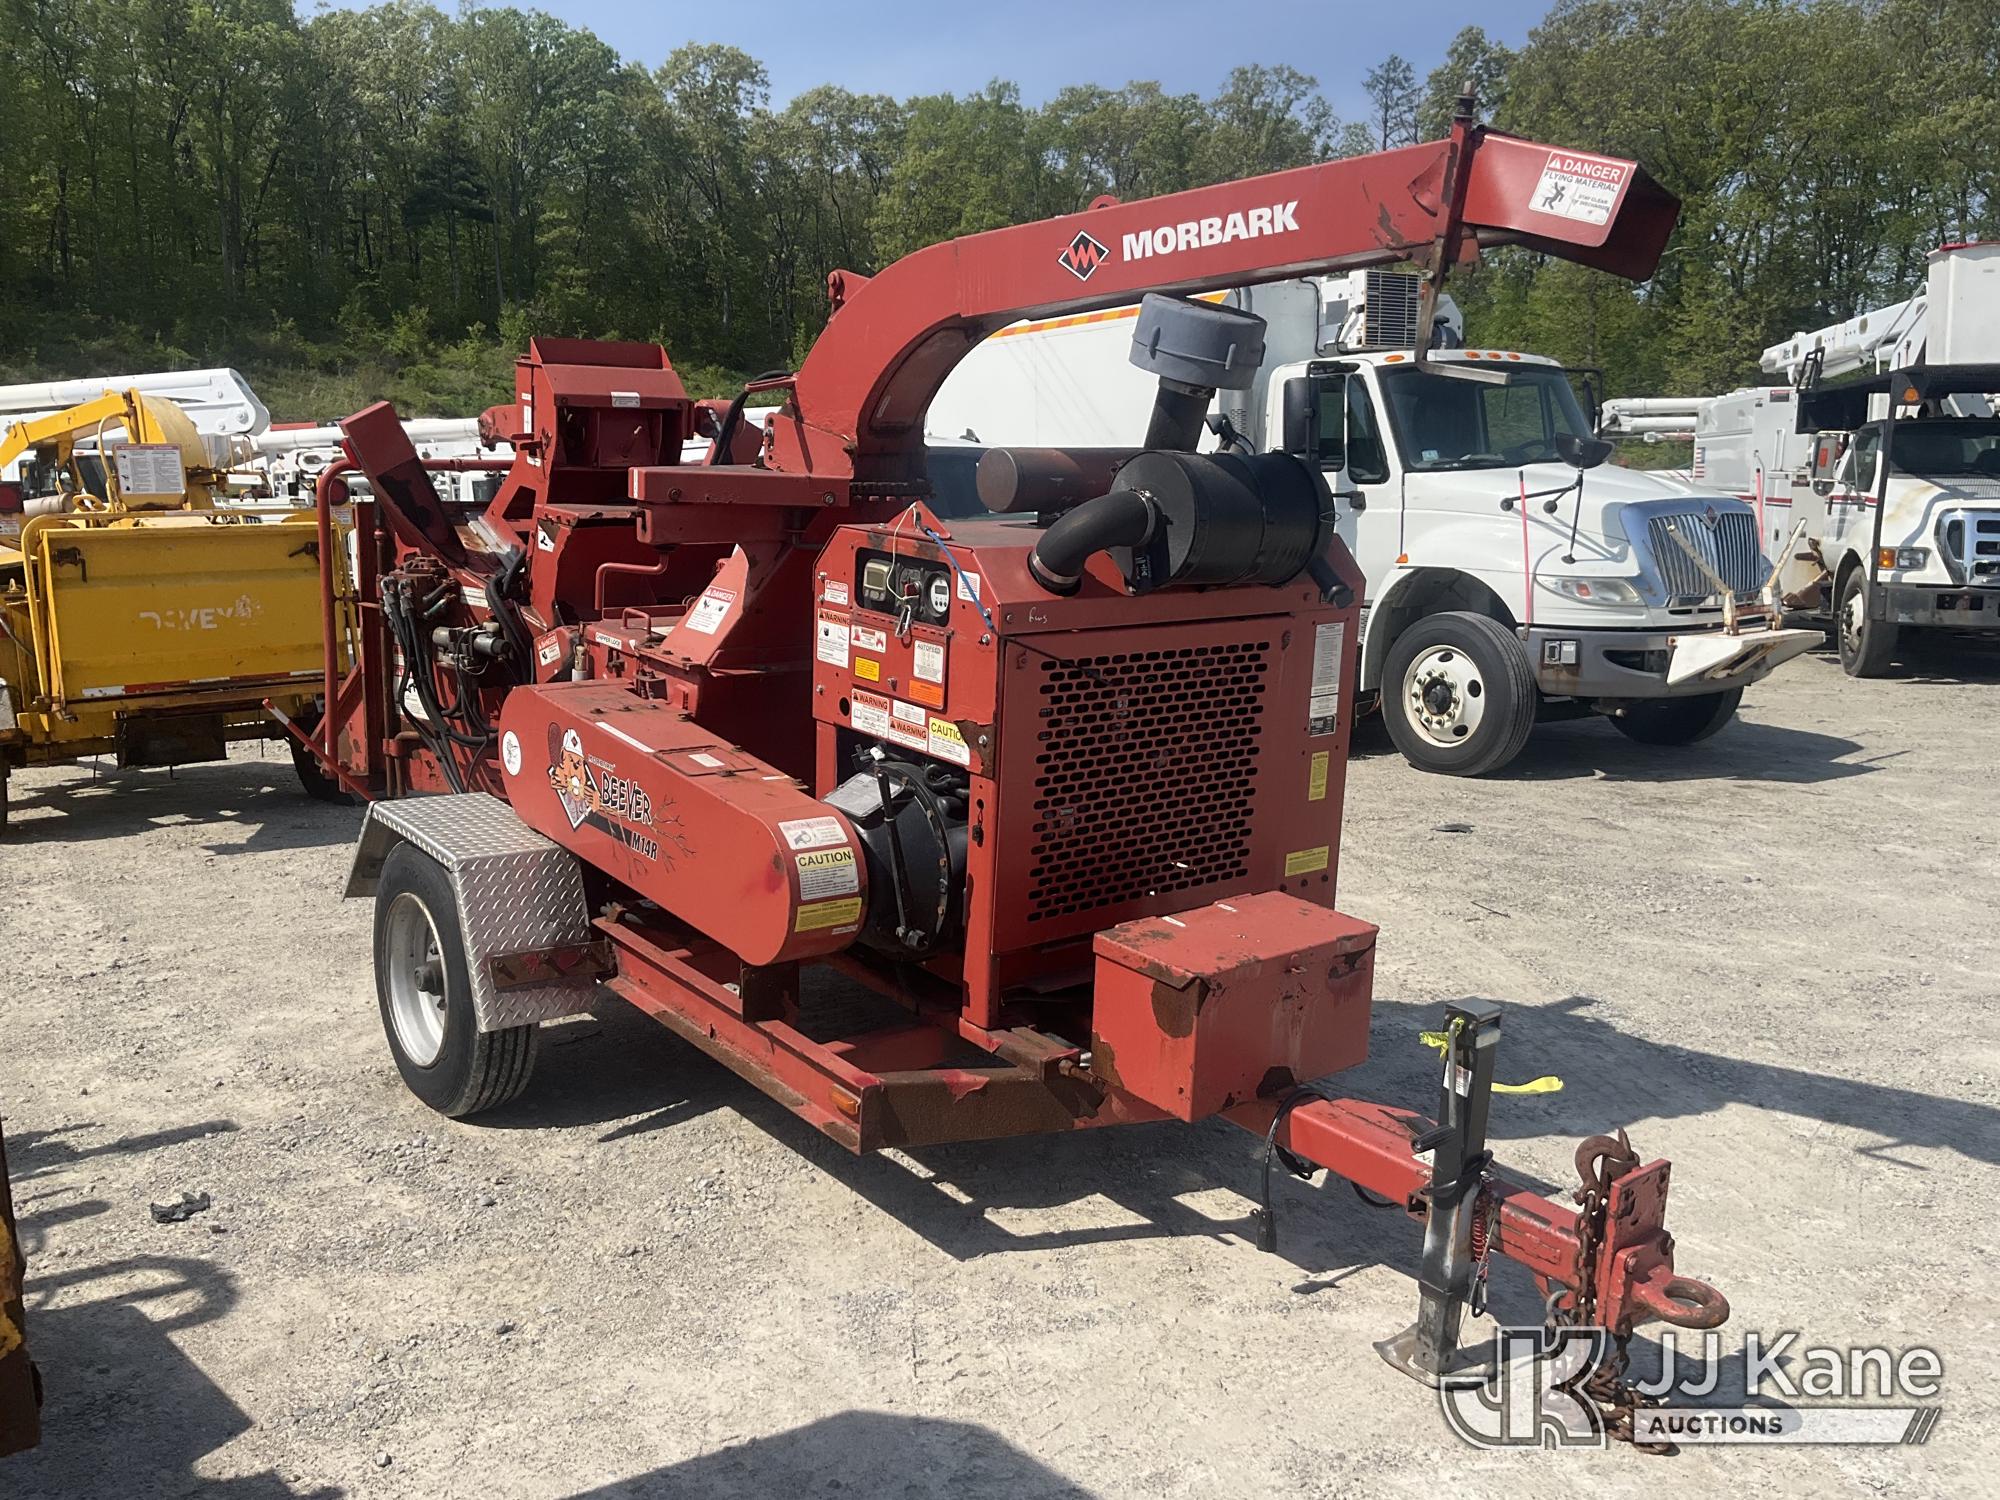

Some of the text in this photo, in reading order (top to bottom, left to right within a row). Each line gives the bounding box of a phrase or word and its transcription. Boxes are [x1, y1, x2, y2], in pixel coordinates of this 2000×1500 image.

[1562, 159, 1621, 181] DANGER
[1544, 170, 1617, 193] FLYING MATERIAL
[1122, 201, 1299, 262] MORBARK
[859, 694, 888, 710] WARNING
[896, 722, 927, 739] WARNING
[931, 721, 964, 742] CAUTIO
[602, 771, 652, 825] BEEVER
[631, 831, 658, 861] M14R
[798, 850, 852, 867] CAUTION
